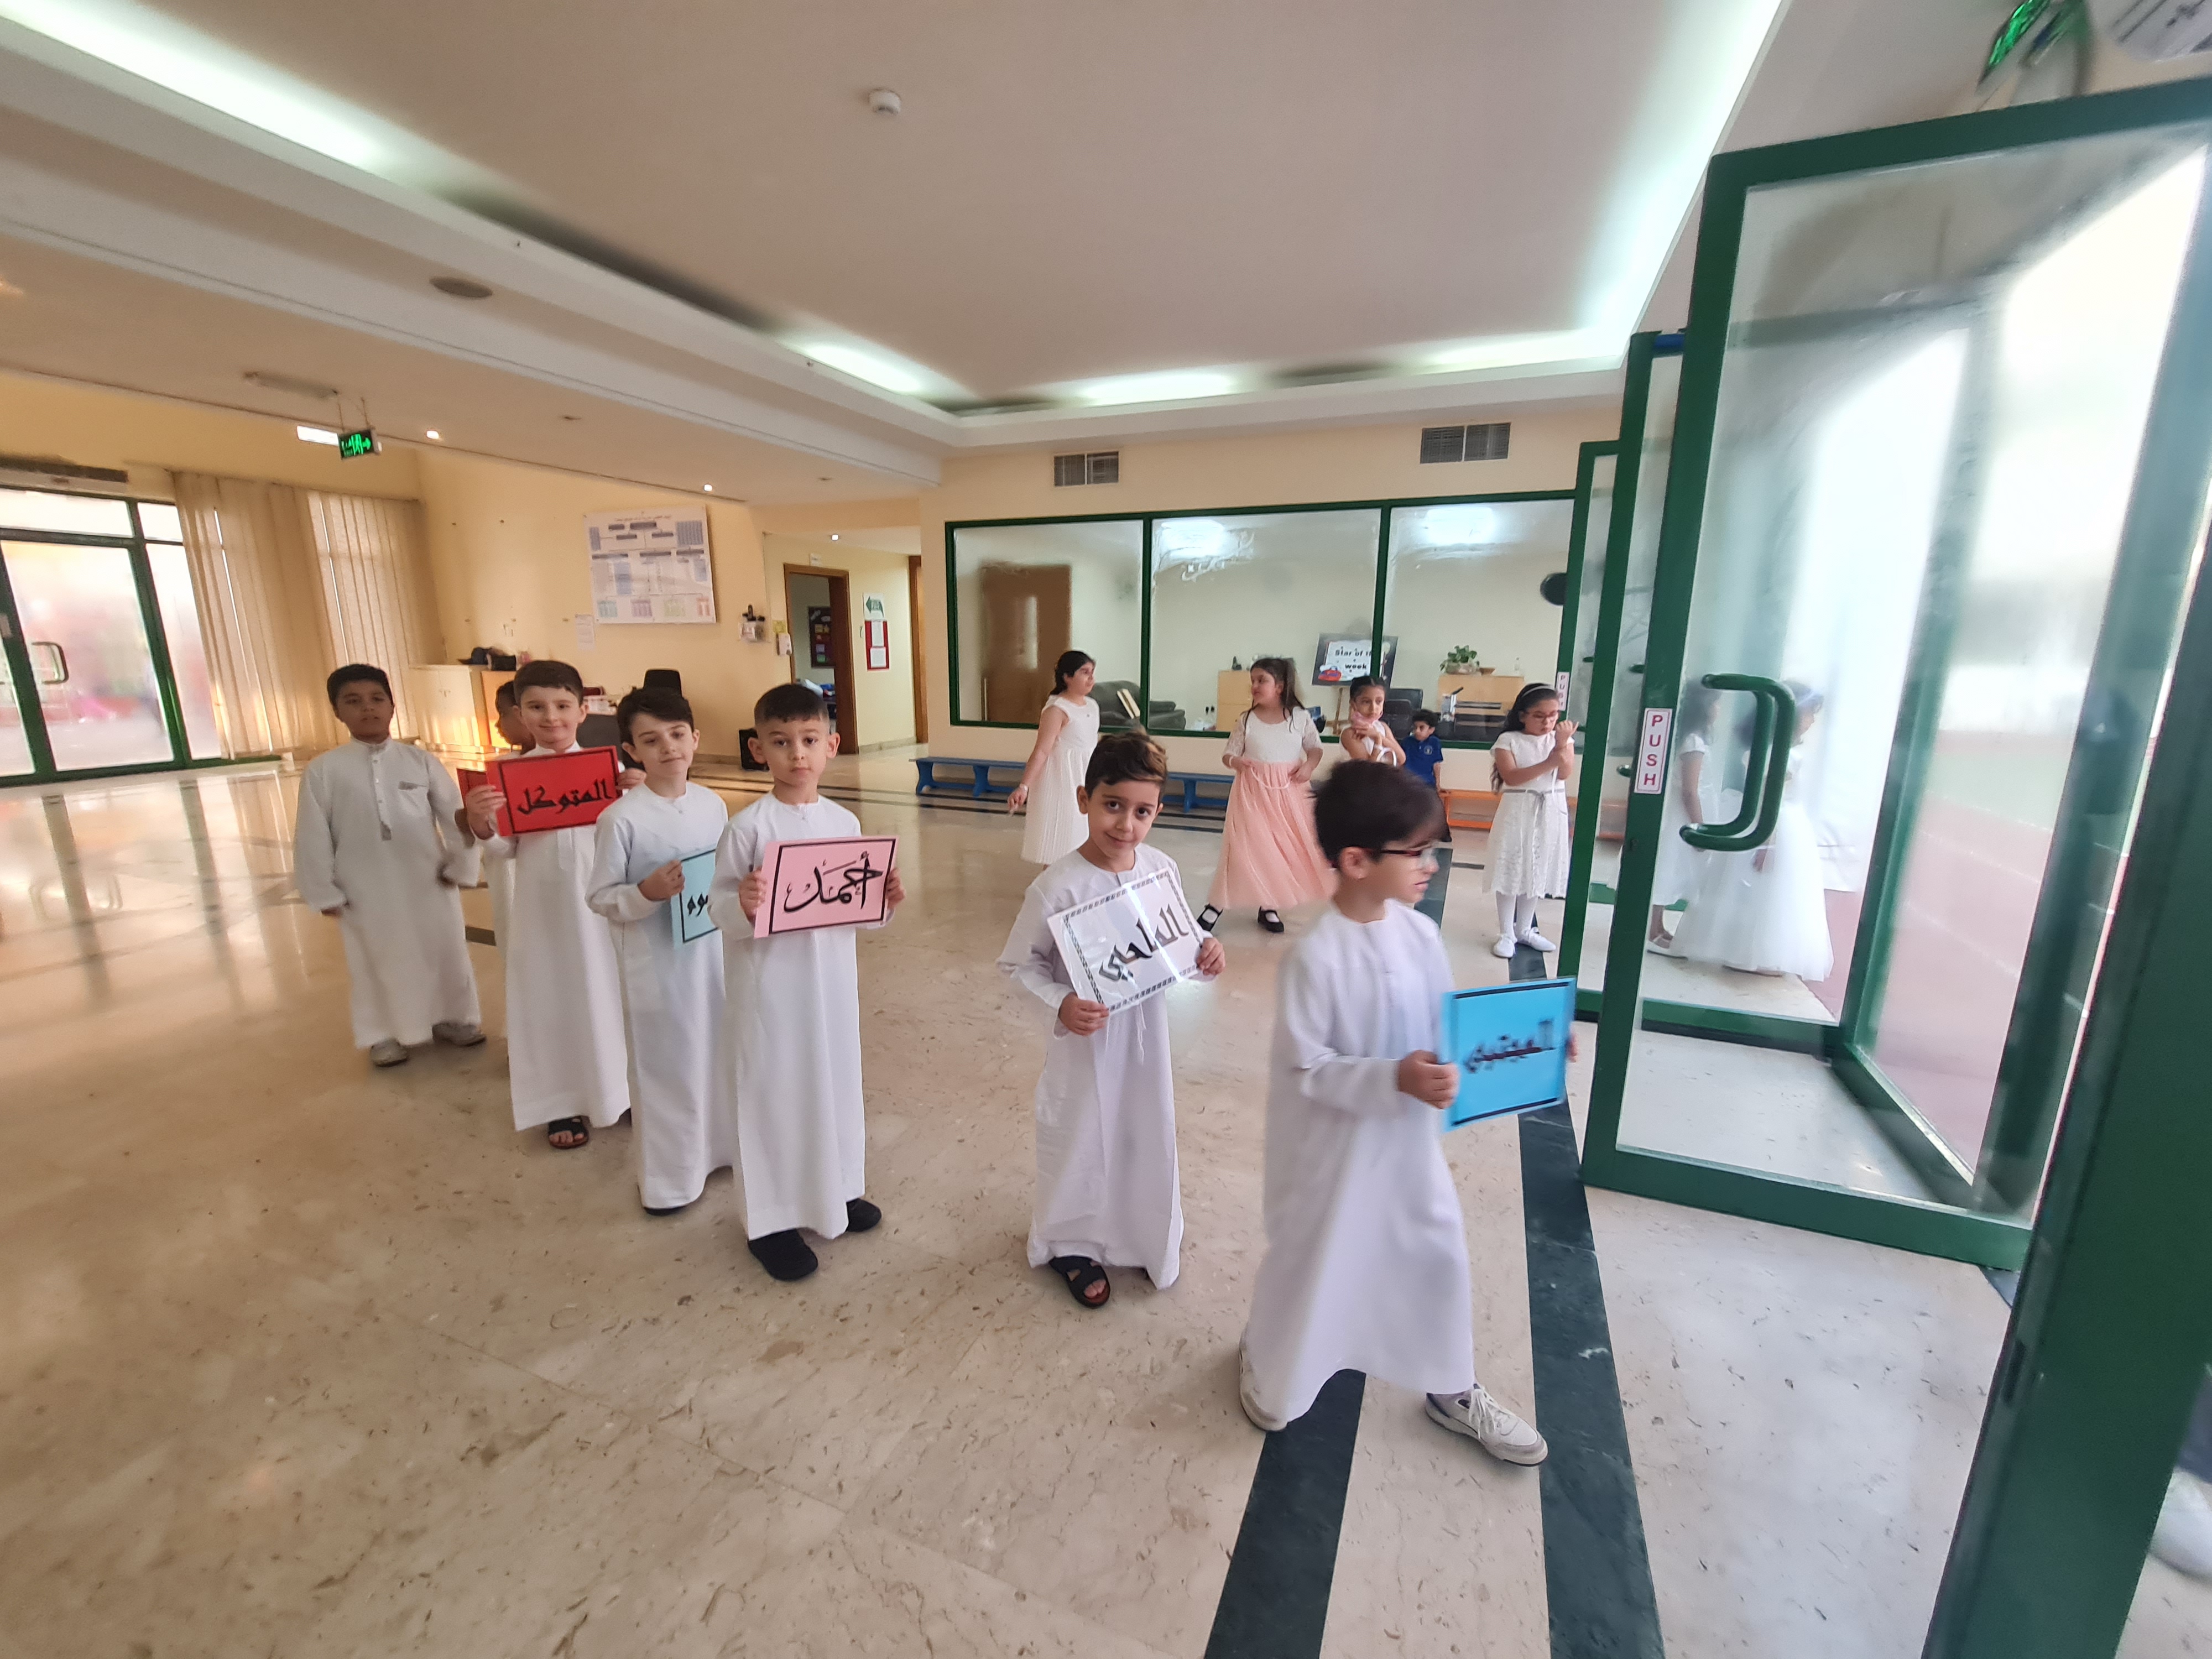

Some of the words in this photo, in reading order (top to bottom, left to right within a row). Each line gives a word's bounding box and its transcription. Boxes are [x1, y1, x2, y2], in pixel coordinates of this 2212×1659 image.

[1643, 714, 1663, 786] PUSH
[517, 778, 614, 815] المتوكل
[1098, 902, 1190, 982] الماحي
